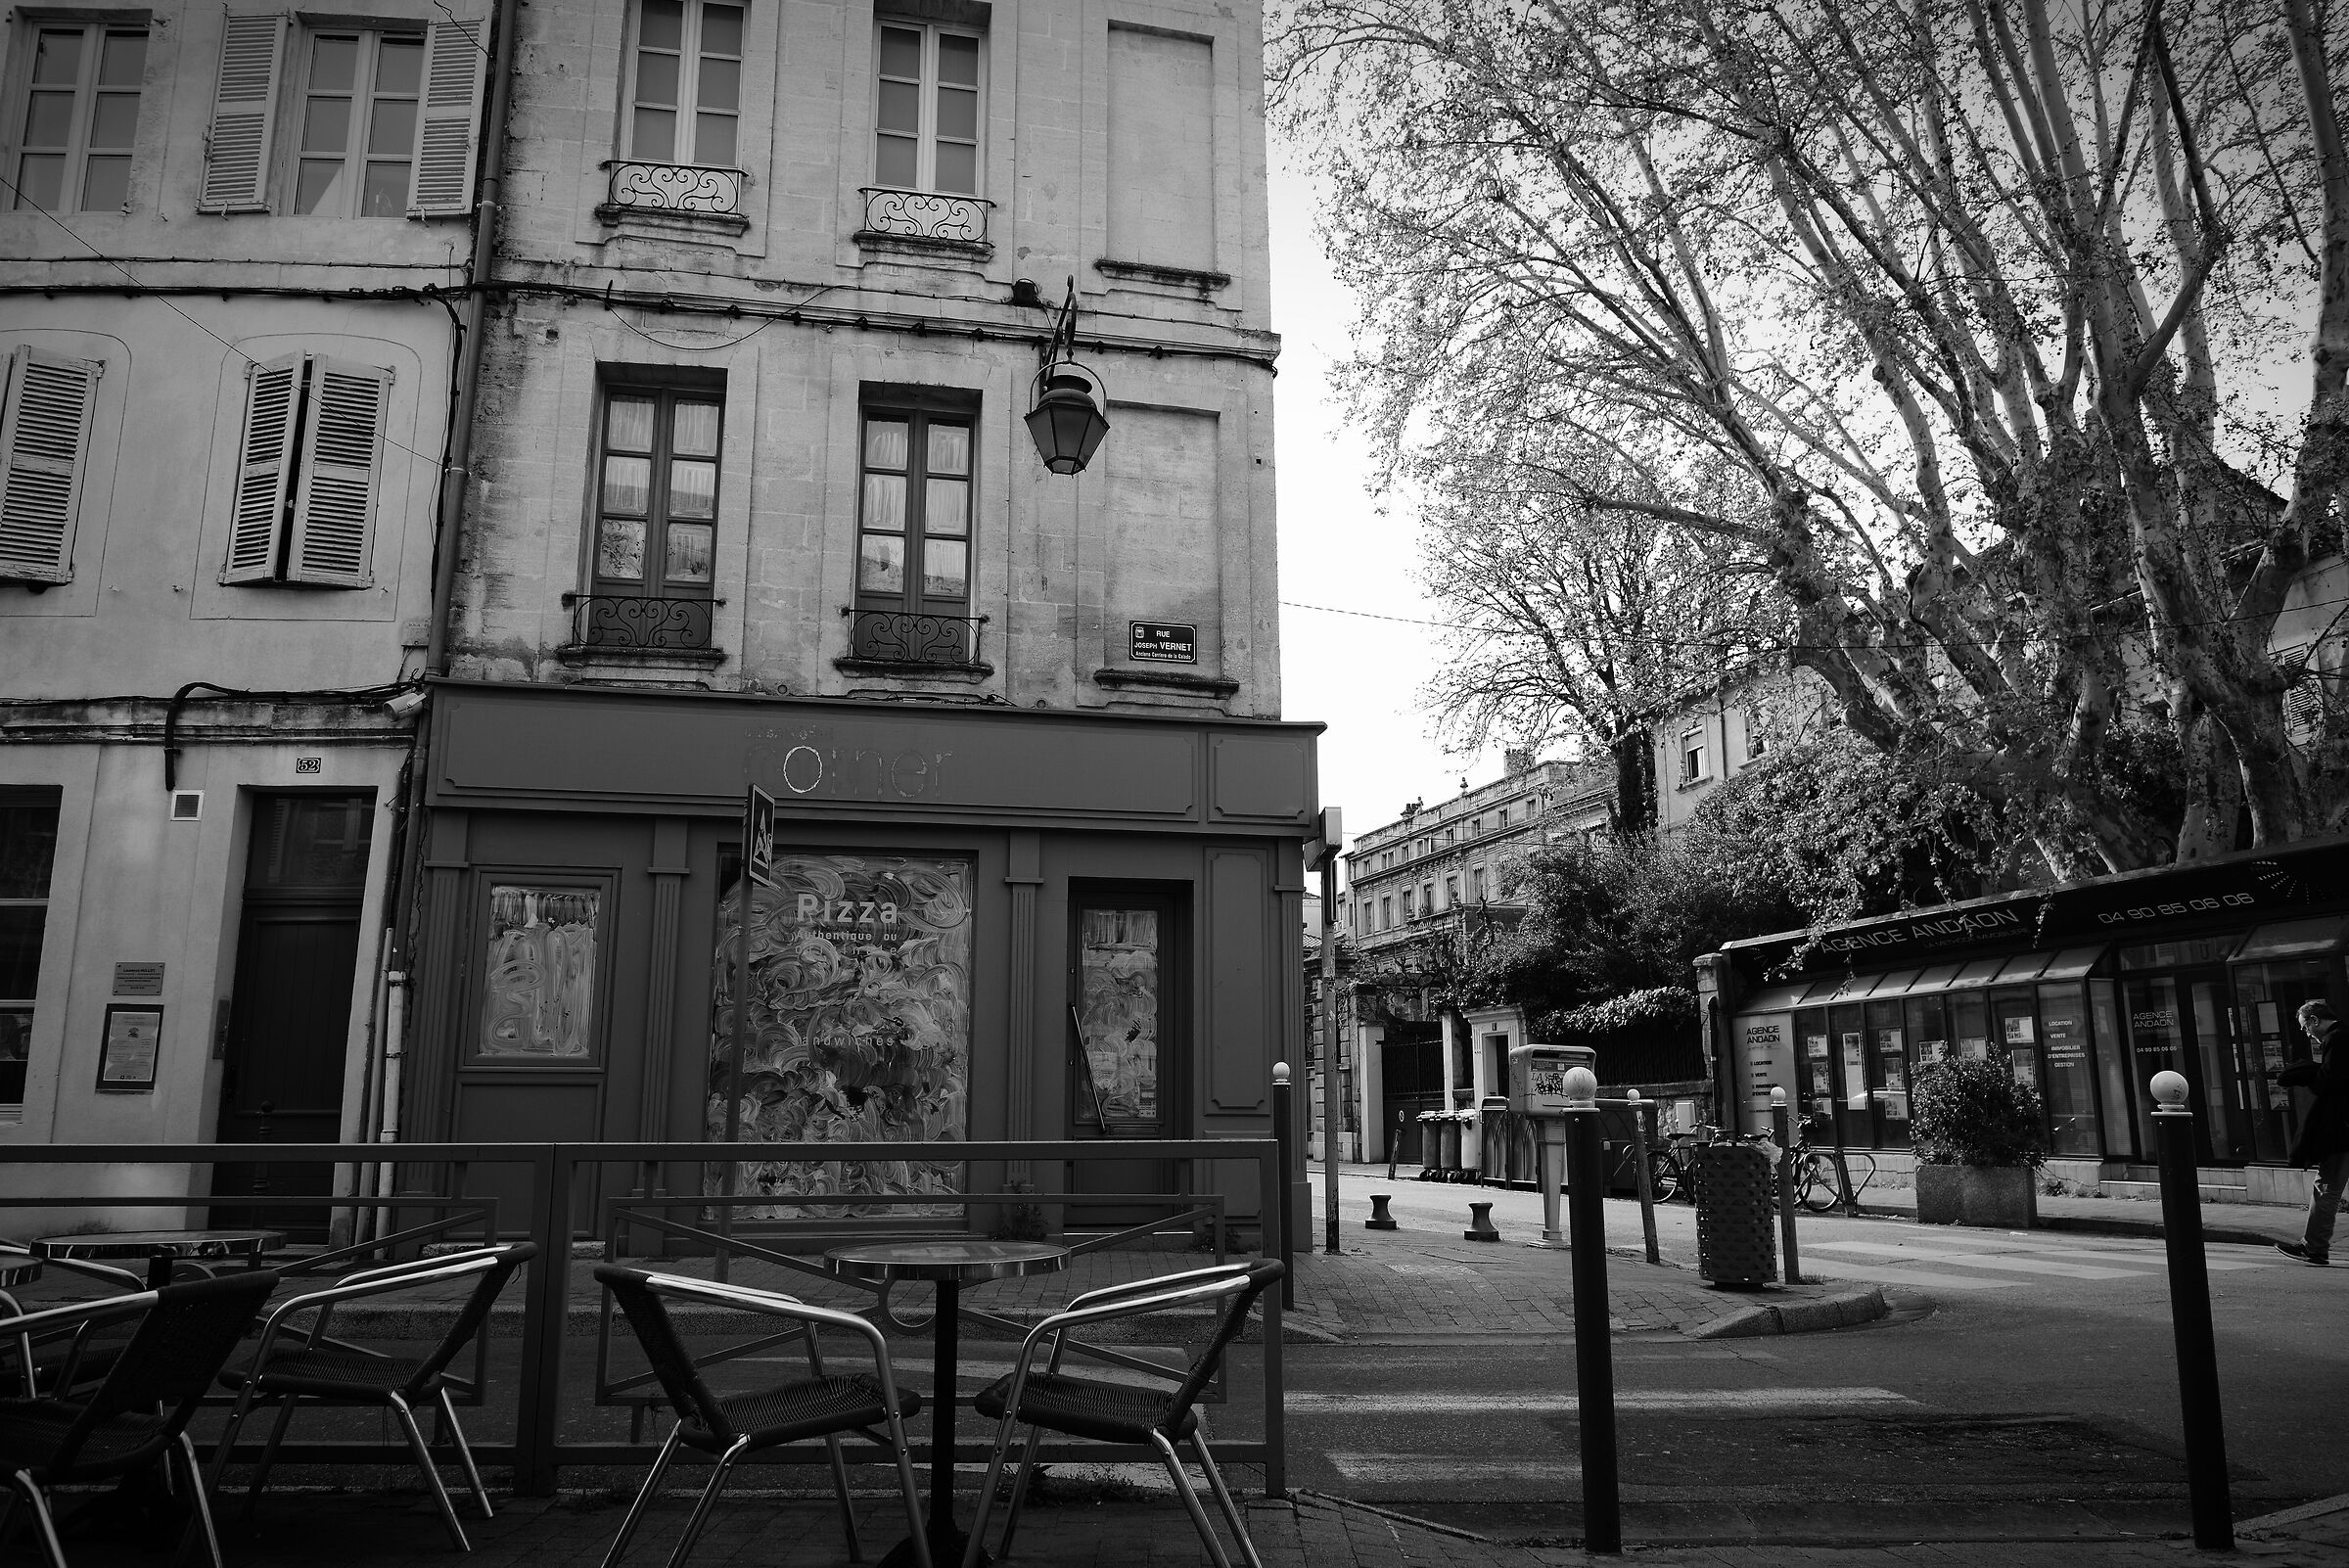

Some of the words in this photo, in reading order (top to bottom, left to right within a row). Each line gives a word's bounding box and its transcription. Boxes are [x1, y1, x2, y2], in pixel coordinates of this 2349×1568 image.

[1134, 641, 1158, 650] JOSEPH
[1160, 641, 1192, 652] VERNET
[300, 760, 316, 770] 52
[797, 893, 898, 924] Pizza
[2097, 911, 2125, 924] 04
[2127, 906, 2156, 920] 90
[2157, 902, 2188, 915] 85
[2189, 898, 2221, 910] 06
[2222, 892, 2255, 906] 06
[797, 930, 872, 943] Authentique
[883, 933, 898, 942] ou
[1819, 928, 1908, 954] AGENCE
[1911, 908, 2020, 940] ANDAON
[2133, 1010, 2173, 1020] AGENCE
[2134, 1019, 2174, 1028] ANDAON
[1746, 1025, 1779, 1036] AGENCE
[801, 1035, 895, 1046] andwiches
[1747, 1035, 1780, 1044] ANDAON
